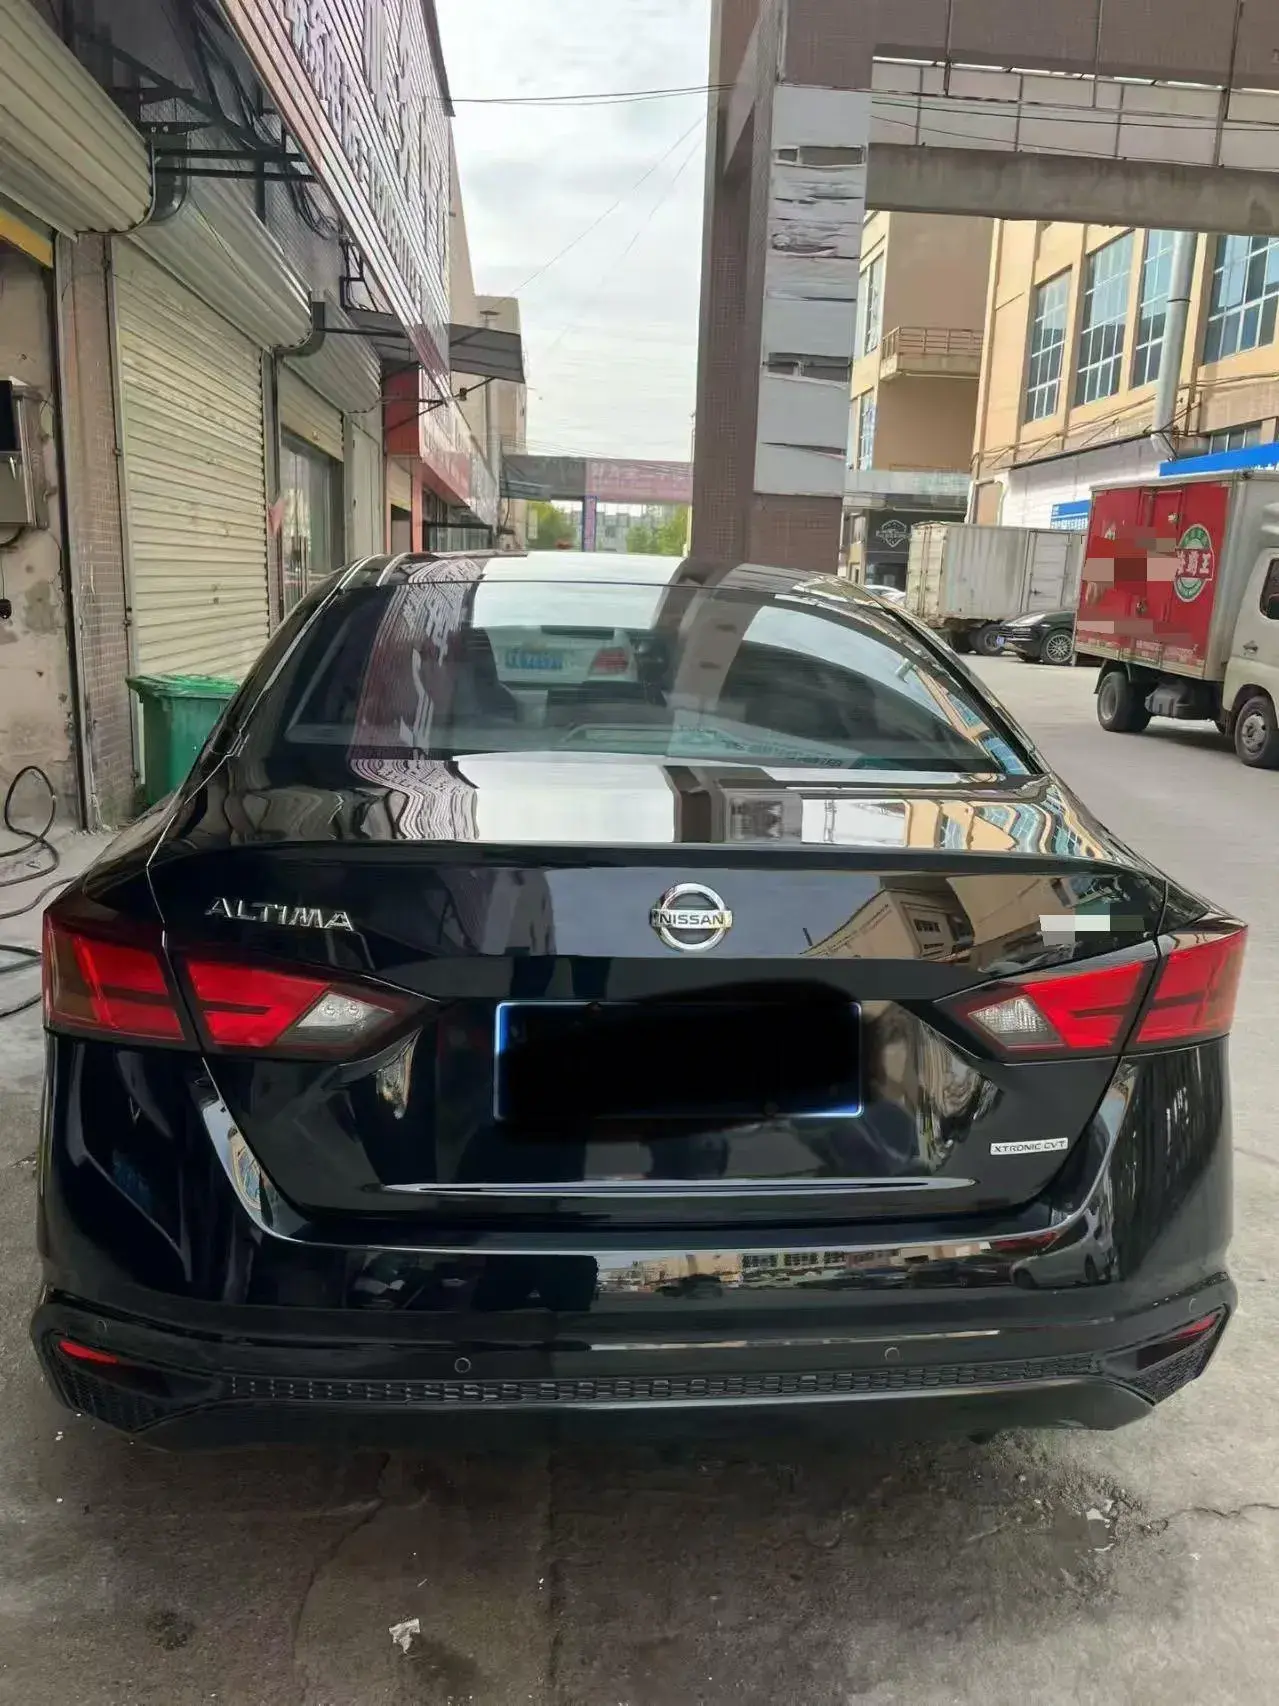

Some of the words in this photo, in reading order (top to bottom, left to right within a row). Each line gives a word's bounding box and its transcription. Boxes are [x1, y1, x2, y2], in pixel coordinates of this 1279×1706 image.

[205, 897, 355, 932] ALTIMA
[659, 913, 724, 925] NISSAN
[994, 1143, 1041, 1153] XTRONIC
[1043, 1140, 1066, 1149] CVT
